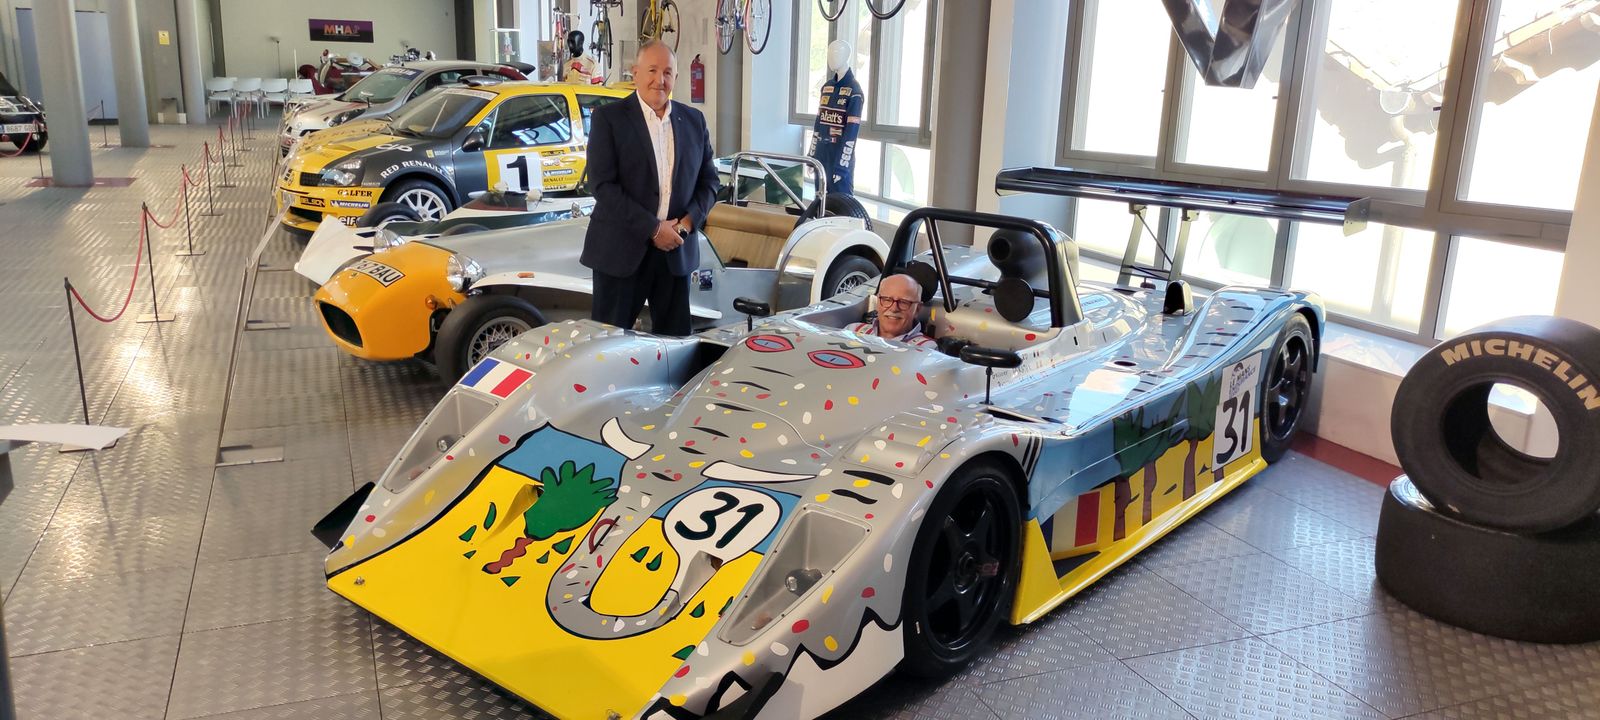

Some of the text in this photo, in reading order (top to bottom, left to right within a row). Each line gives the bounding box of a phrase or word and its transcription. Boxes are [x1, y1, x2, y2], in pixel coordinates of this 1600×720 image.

[380, 160, 443, 179] RED RENAULT
[840, 141, 854, 167] SEGA
[506, 155, 530, 191] 1
[337, 189, 373, 197] GALFER
[1440, 338, 1600, 411] MICHELIN
[1215, 390, 1251, 464] 31
[674, 491, 765, 549] 31
